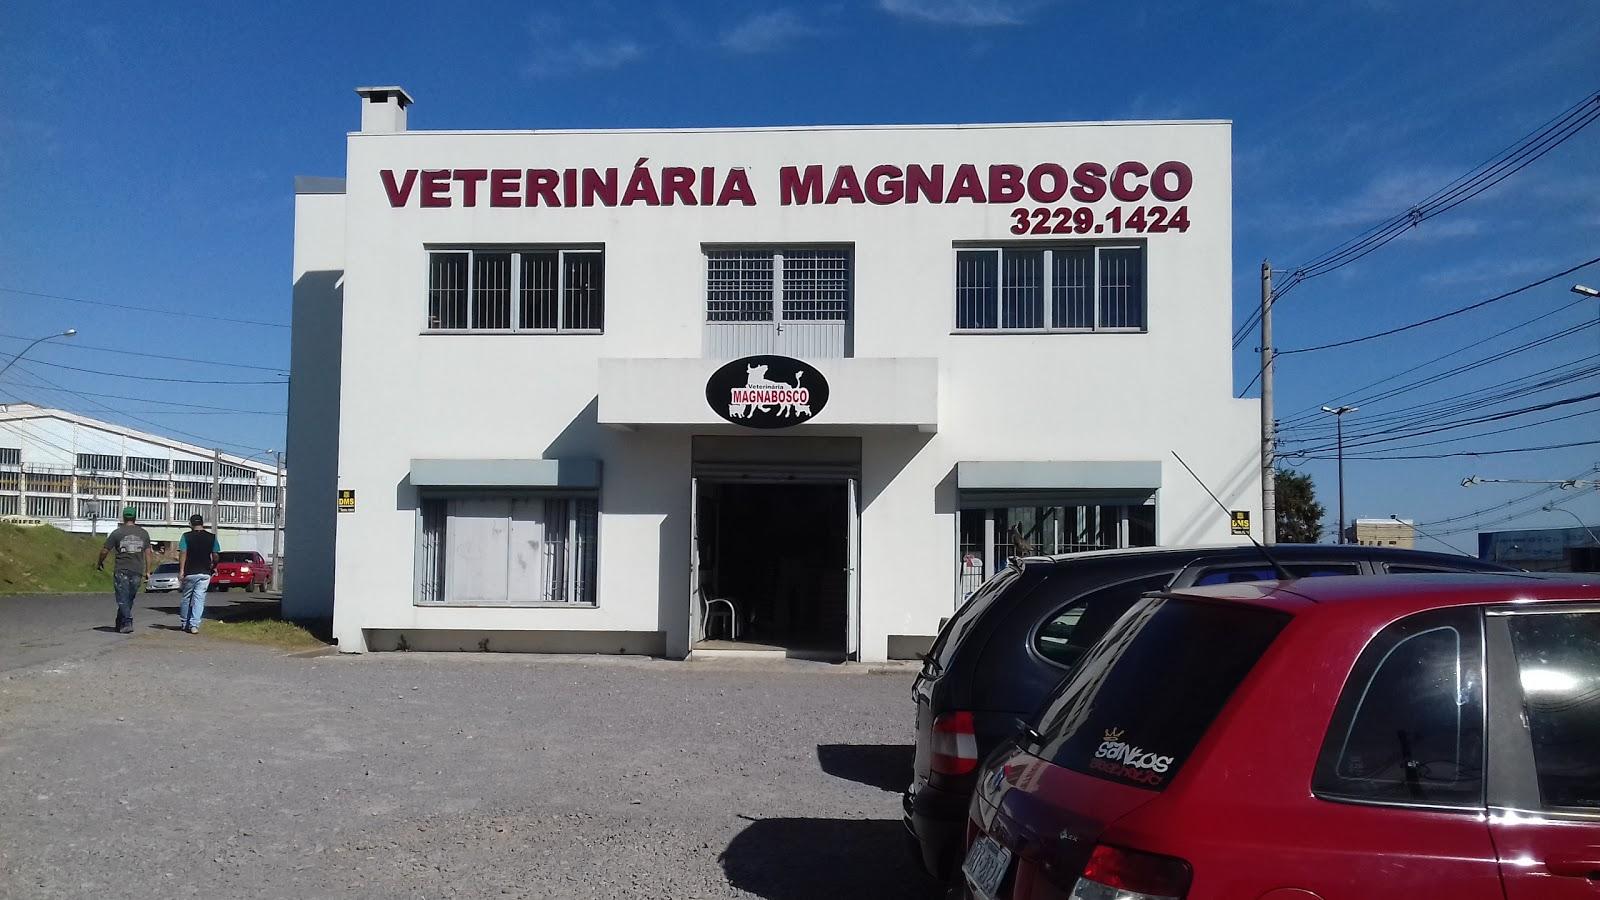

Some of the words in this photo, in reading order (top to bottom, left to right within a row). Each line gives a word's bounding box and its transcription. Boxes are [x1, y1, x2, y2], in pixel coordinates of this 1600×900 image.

[379, 157, 757, 208] VETERINÁRIA
[779, 160, 1194, 206] MAGNABOSCO
[1010, 206, 1191, 235] 3229.1424
[733, 390, 807, 403] MAGNABOSCO
